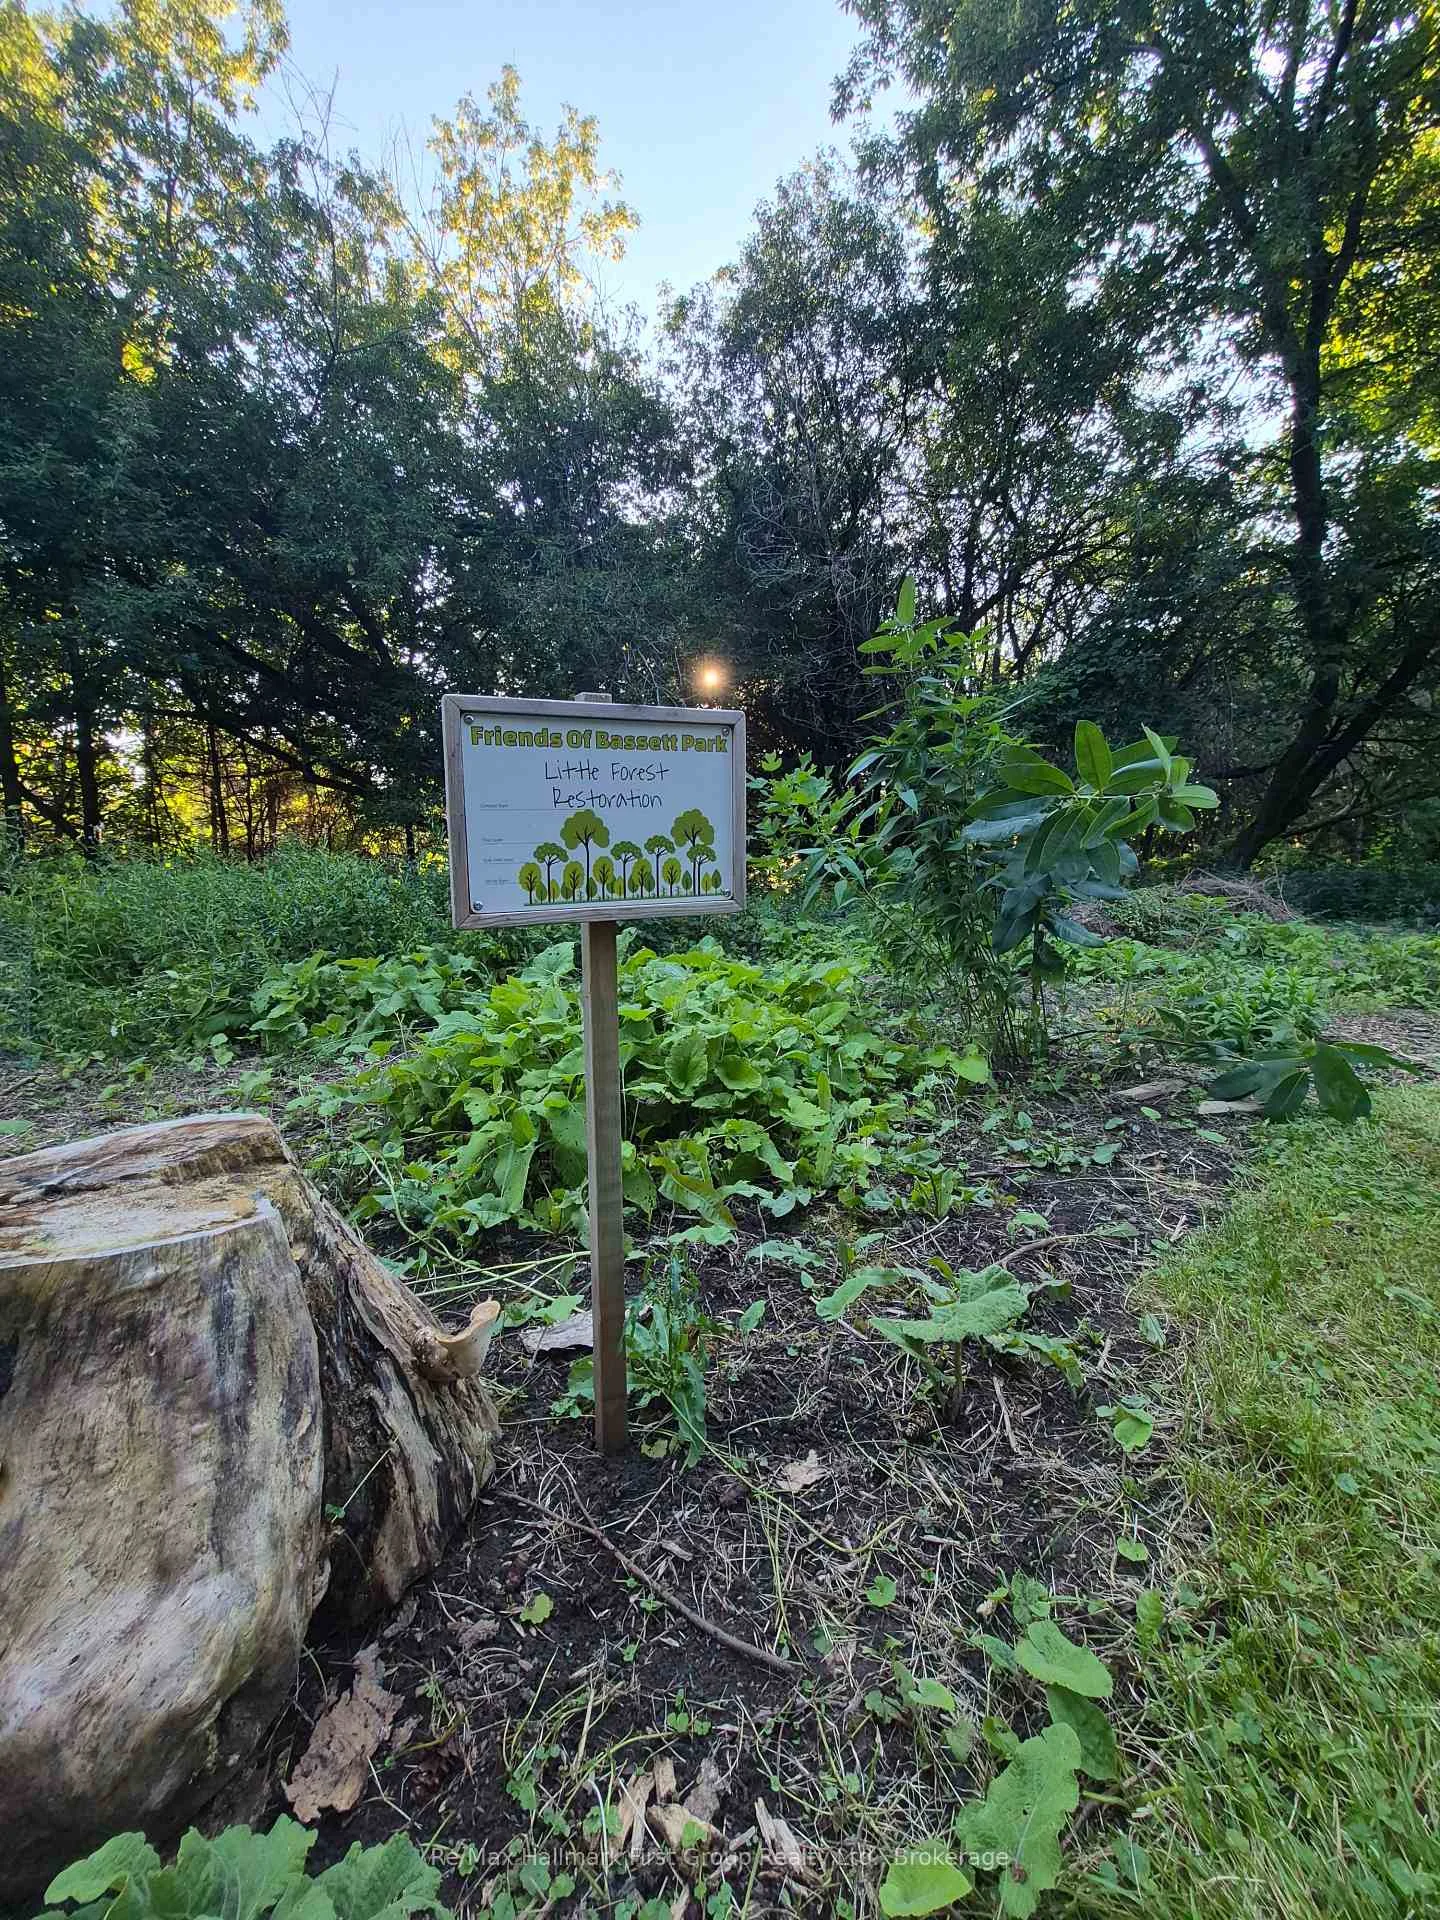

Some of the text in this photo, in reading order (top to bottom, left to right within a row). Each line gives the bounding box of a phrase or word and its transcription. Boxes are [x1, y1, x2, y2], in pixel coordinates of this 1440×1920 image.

[469, 726, 728, 752] Friends Of Bassett Park
[544, 759, 670, 781] Little Forest
[552, 787, 663, 809] Restoration
